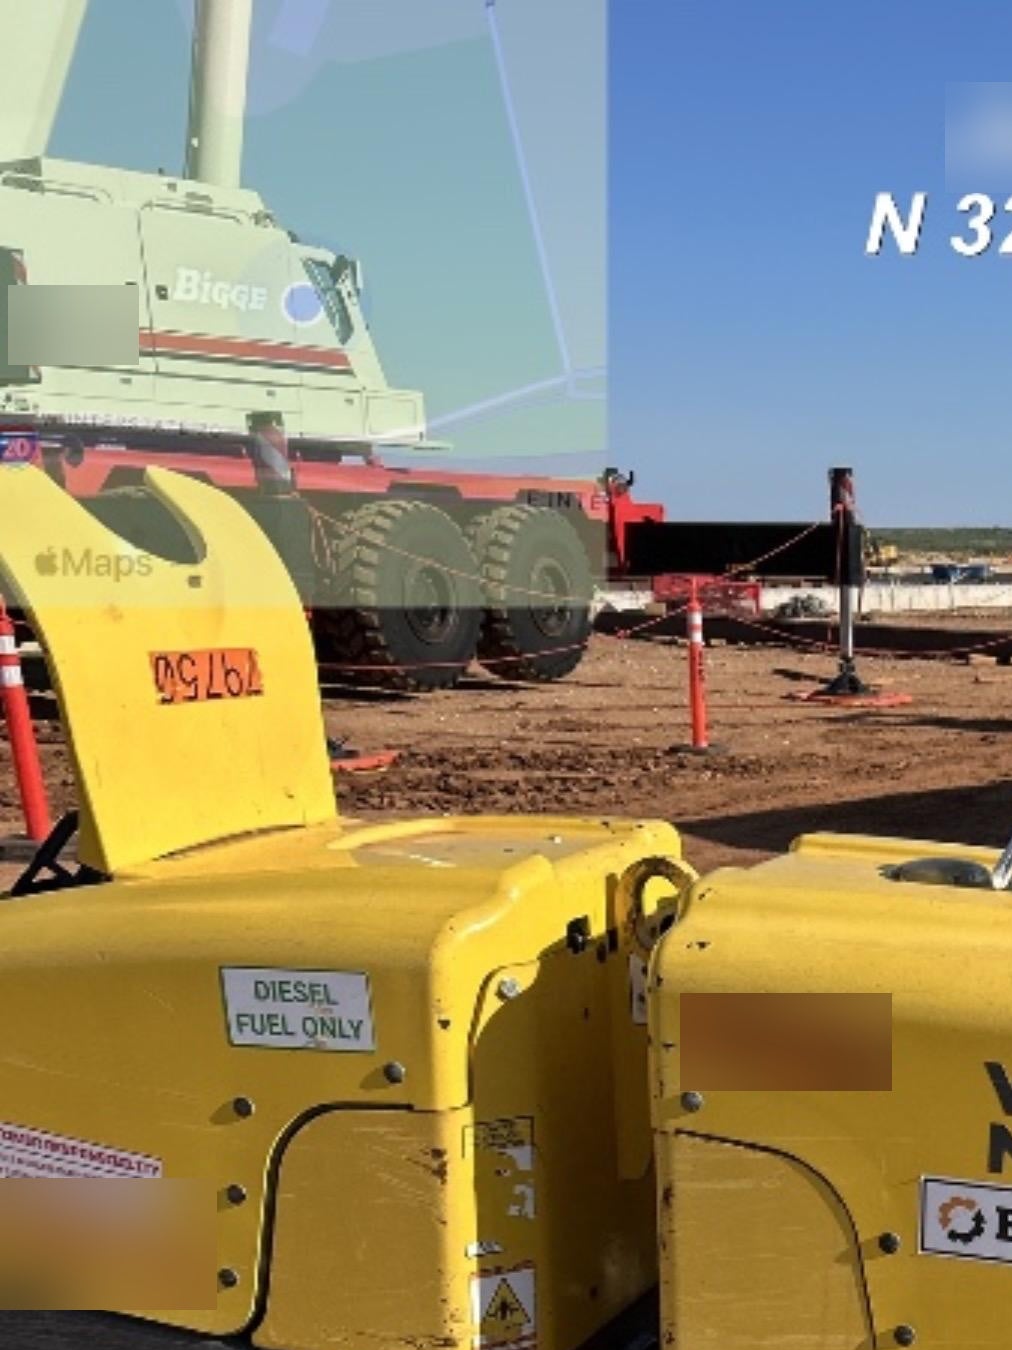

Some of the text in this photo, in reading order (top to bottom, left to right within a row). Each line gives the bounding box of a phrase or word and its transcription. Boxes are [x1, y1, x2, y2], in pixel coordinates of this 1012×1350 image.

[254, 980, 340, 1006] DIESEL
[235, 1012, 364, 1041] FUEL ONLY
